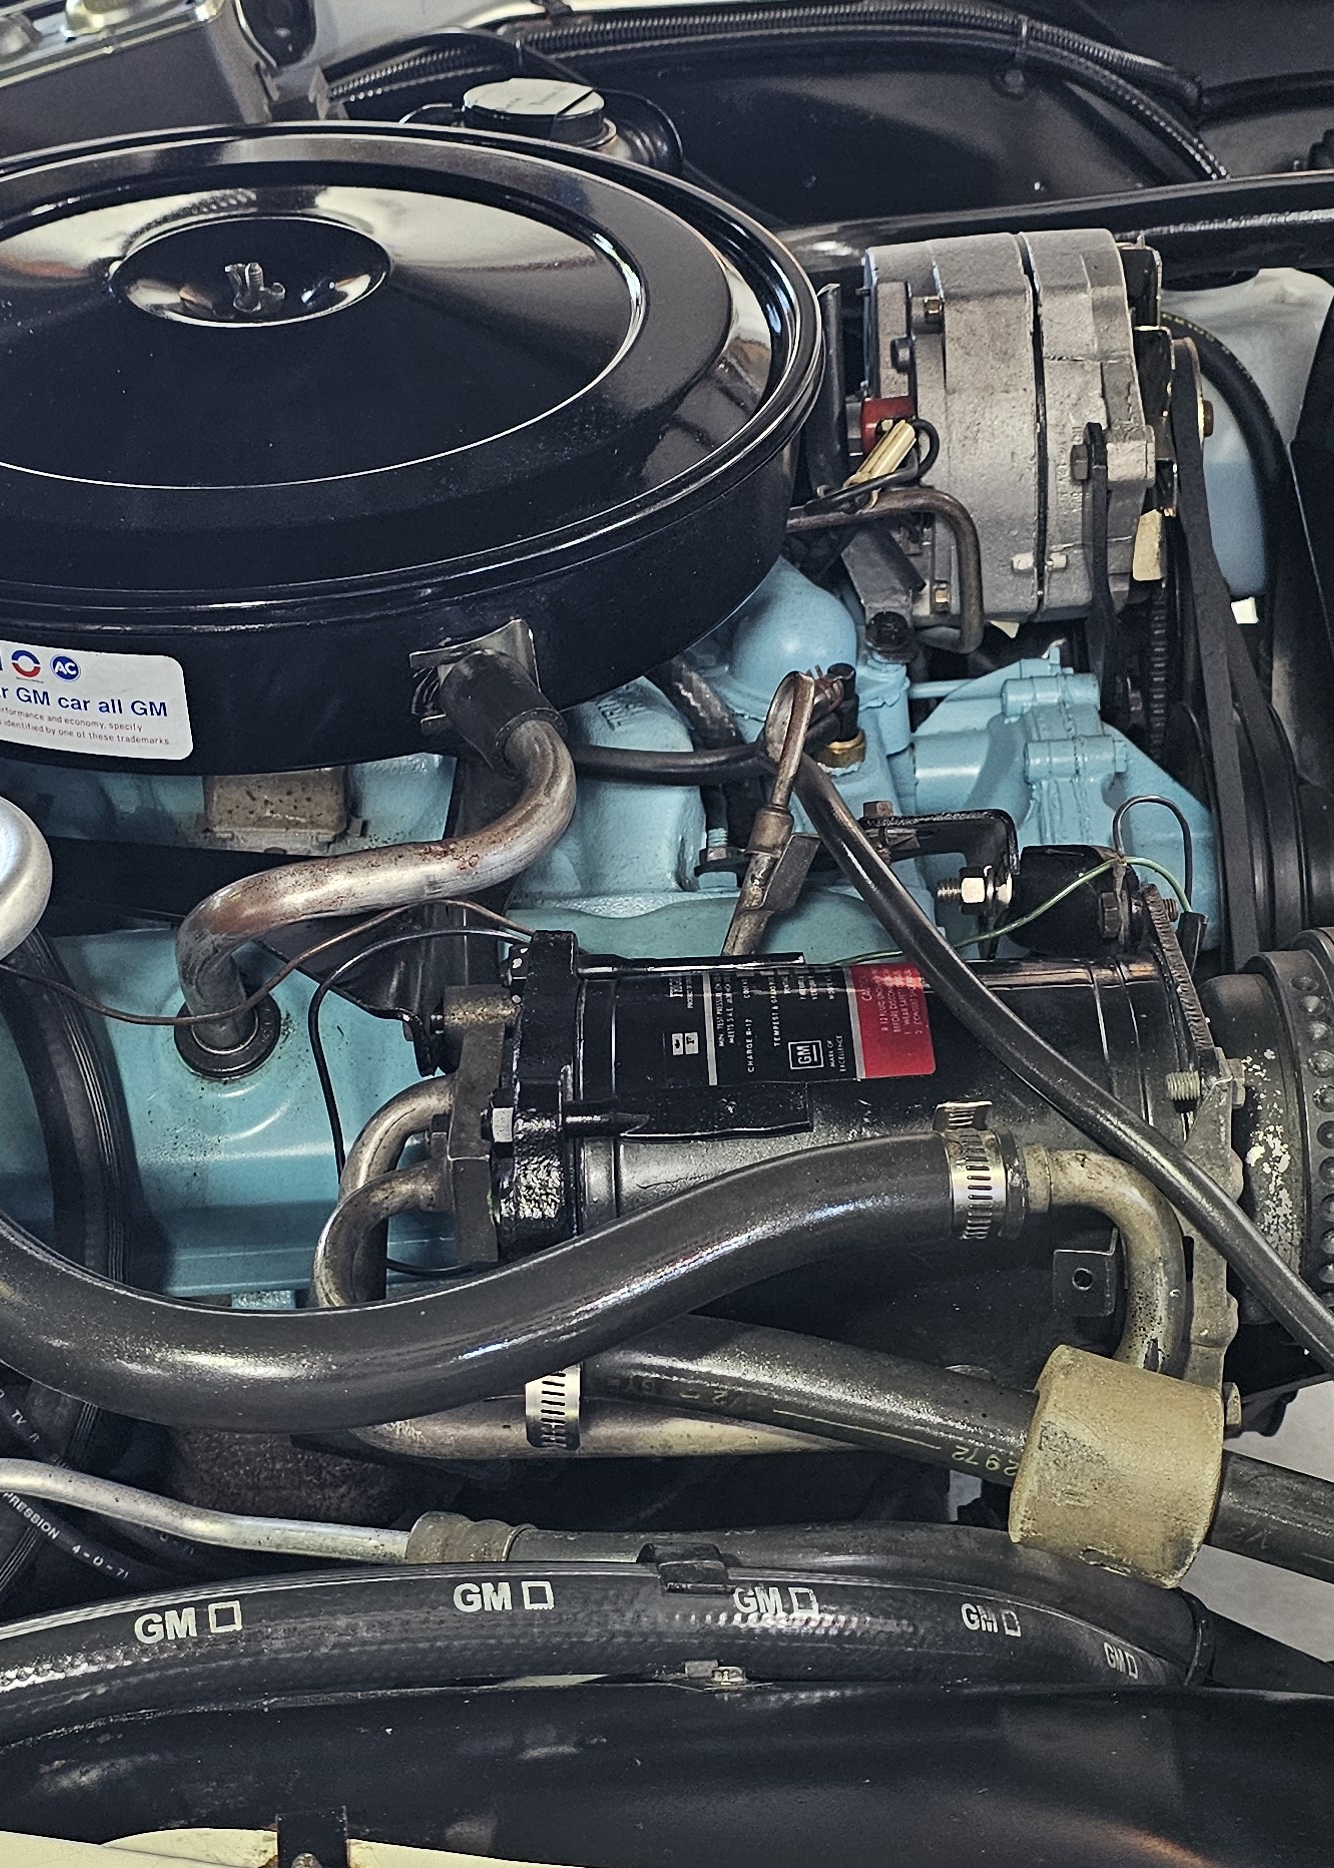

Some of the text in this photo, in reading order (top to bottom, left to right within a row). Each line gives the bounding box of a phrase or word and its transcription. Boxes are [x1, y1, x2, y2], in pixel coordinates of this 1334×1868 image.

[54, 660, 78, 676] AC
[16, 686, 51, 706] GM
[57, 695, 91, 712] car
[98, 698, 124, 714] all
[130, 699, 169, 718] GM
[3, 717, 45, 734] identified
[45, 726, 57, 736] by
[58, 728, 75, 738] one
[76, 730, 86, 740] of
[88, 732, 115, 743] these
[46, 714, 63, 724] and
[64, 716, 108, 731] economy,
[108, 721, 143, 734] specify
[771, 1011, 782, 1047] TEMPEST
[899, 1007, 910, 1026] WEAR
[746, 1038, 755, 1073] CHARGE
[796, 1044, 813, 1065] GM
[827, 1049, 836, 1068] MARK
[835, 1035, 847, 1073] EXCELLENCE
[11, 1408, 27, 1426] TV
[453, 1581, 513, 1613] GM
[732, 1585, 784, 1614] GM
[134, 1606, 197, 1645] GM
[960, 1602, 999, 1634] GM
[1103, 1642, 1126, 1674] GM
